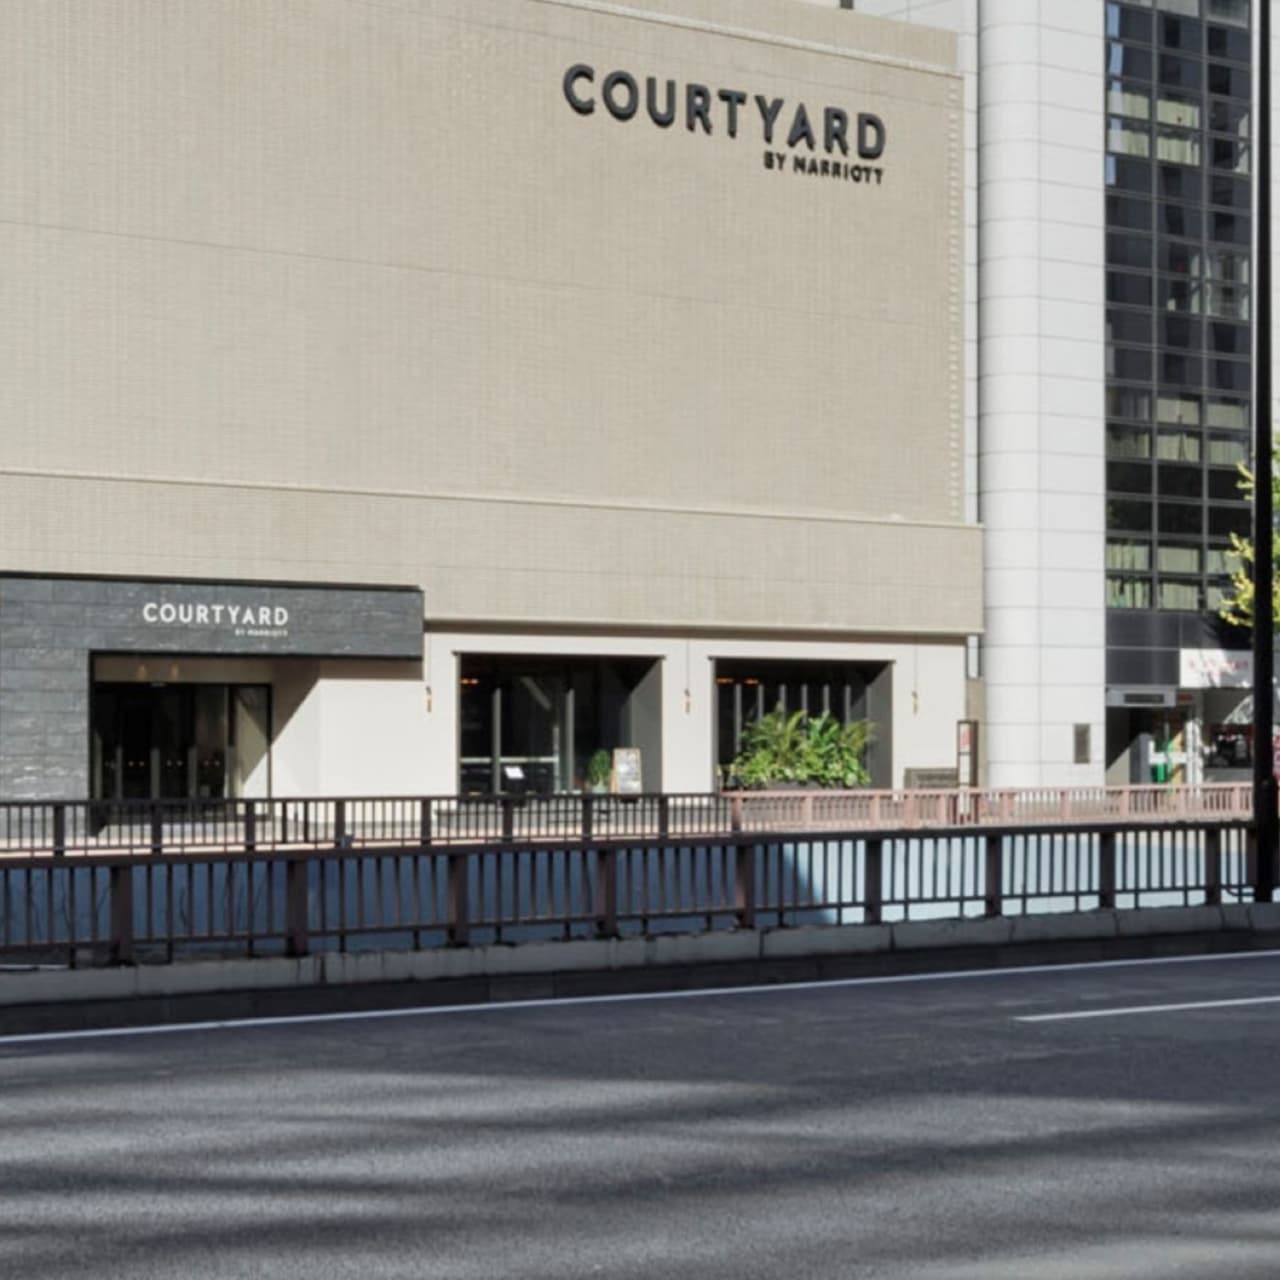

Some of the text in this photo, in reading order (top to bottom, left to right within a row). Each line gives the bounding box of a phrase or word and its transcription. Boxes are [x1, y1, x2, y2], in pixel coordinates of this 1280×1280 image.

[563, 63, 886, 160] COURTYARD
[763, 151, 883, 185] BY MARRIOTT
[143, 602, 289, 626] COURTYARD
